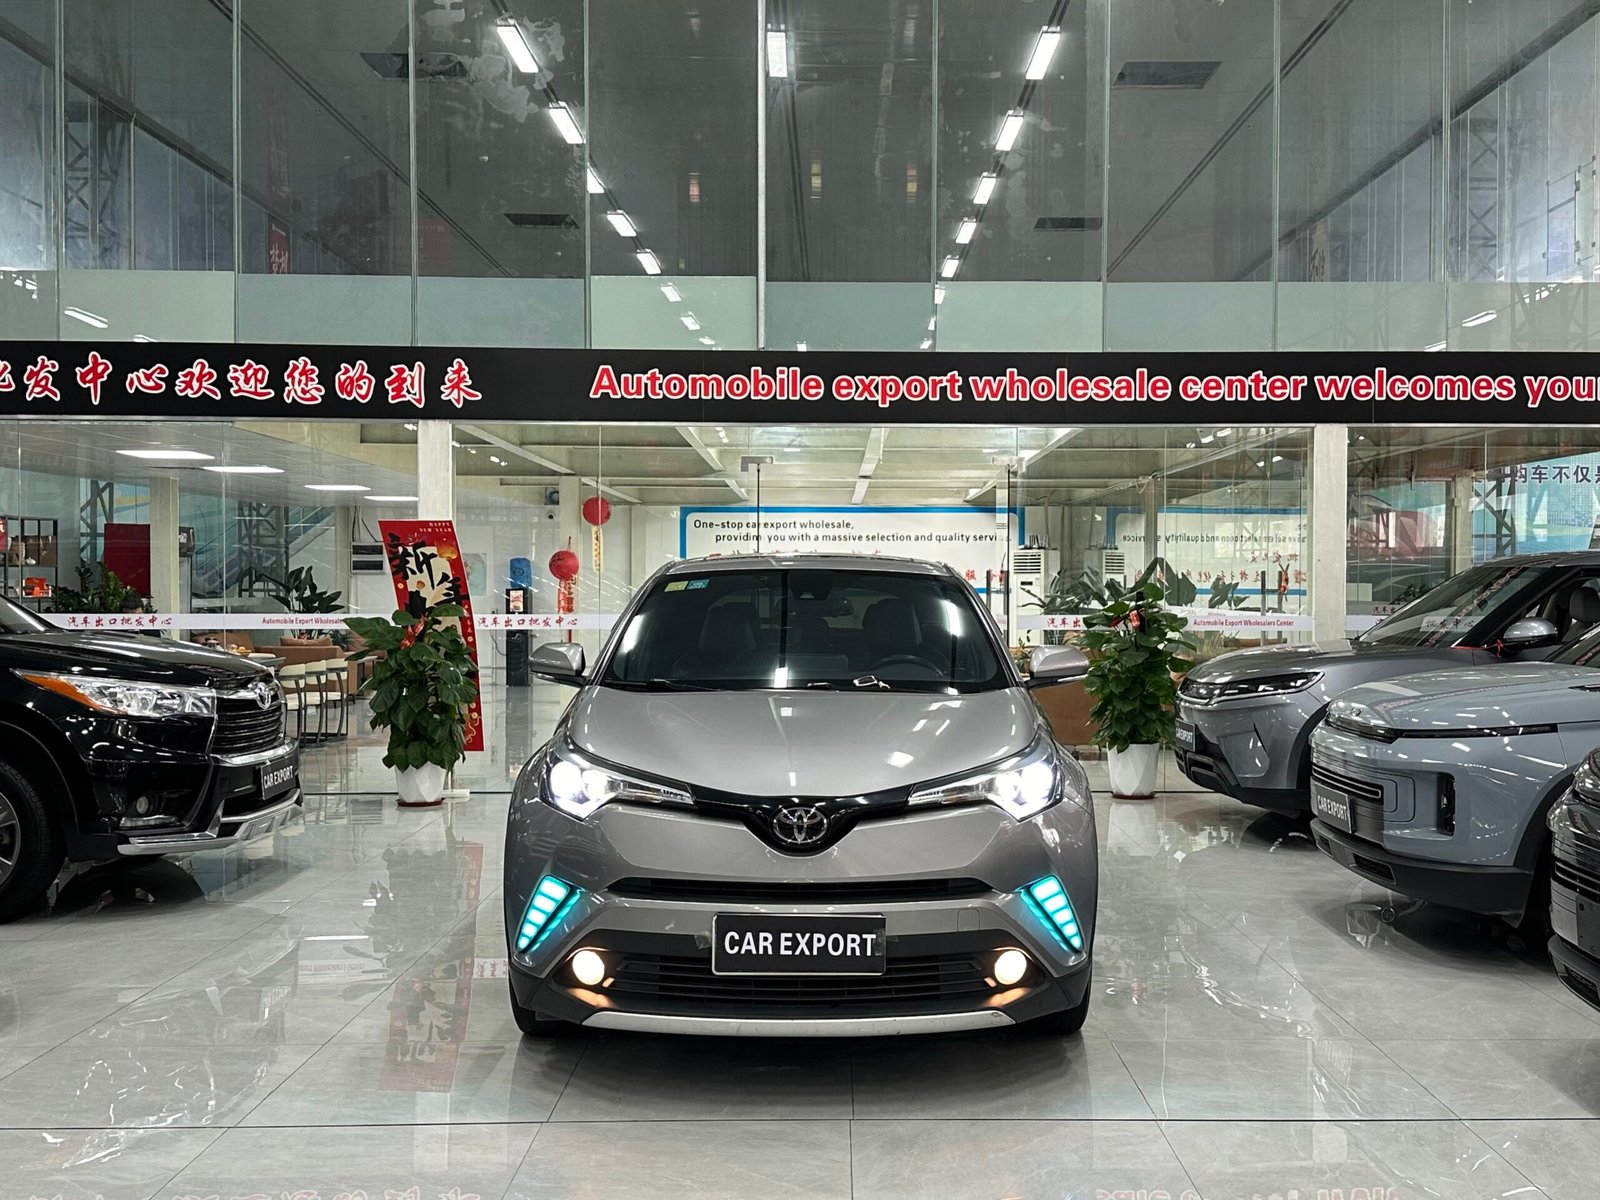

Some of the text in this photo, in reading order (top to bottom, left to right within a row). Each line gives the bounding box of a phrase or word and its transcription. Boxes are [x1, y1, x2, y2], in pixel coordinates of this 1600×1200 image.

[590, 364, 1600, 407] Automobile export wholesale center welcomes you
[694, 518, 855, 531] One-stop ca export wholesale,
[715, 532, 762, 543] providin
[768, 534, 786, 543] you
[789, 532, 811, 542] with
[814, 534, 819, 542] a
[822, 532, 863, 542] massive
[865, 532, 912, 542] selection
[914, 532, 933, 542] and
[935, 532, 970, 544] quality
[67, 615, 173, 627] 汽车出口批发中心
[262, 616, 294, 625] Automobile
[295, 616, 313, 626] Export
[478, 616, 578, 628] 汽车出口批发中心
[1193, 618, 1224, 627] Automobile
[1225, 618, 1243, 628] Export
[1276, 618, 1295, 627] Center
[264, 765, 293, 789] CAR EXPORT
[1317, 794, 1347, 821] CAR EXPORT
[724, 931, 877, 956] CAR EXPORT
